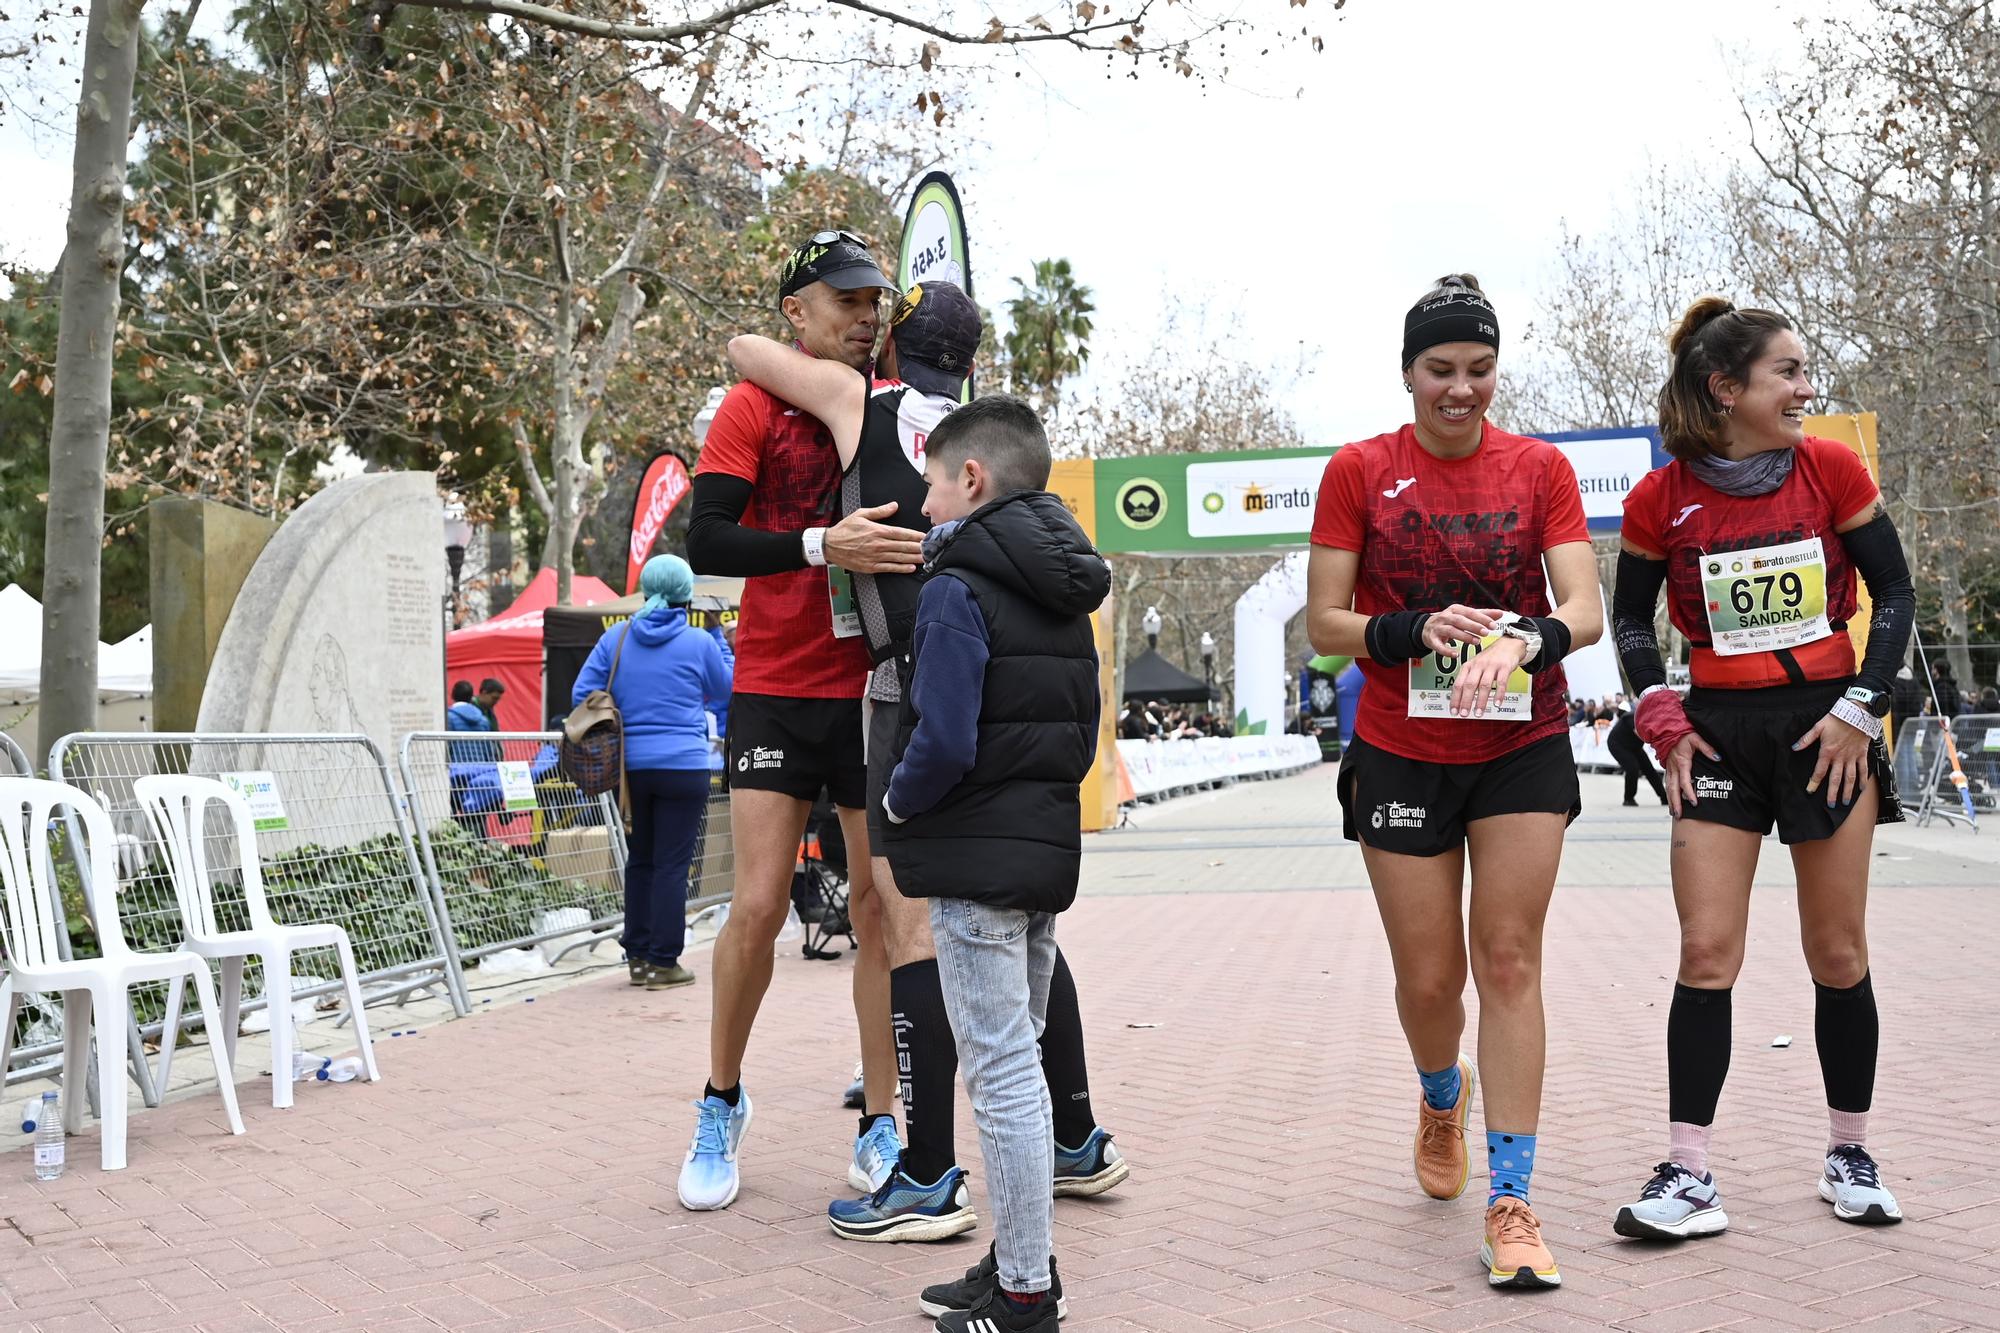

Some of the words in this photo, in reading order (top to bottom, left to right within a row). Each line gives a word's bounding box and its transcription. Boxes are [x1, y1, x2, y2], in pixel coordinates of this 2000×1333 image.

[1419, 294, 1453, 312] Trail
[1246, 487, 1310, 511] marató
[1753, 556, 1784, 569] marató
[1785, 550, 1819, 565] CASTELLÓ
[1730, 572, 1803, 614] 679
[1739, 609, 1803, 628] SANDRA
[753, 749, 784, 761] marató
[1697, 779, 1733, 791] marató
[1696, 789, 1729, 799] CASTELLÓ
[1389, 806, 1426, 818] marató
[1389, 818, 1422, 828] CASTELLÓ
